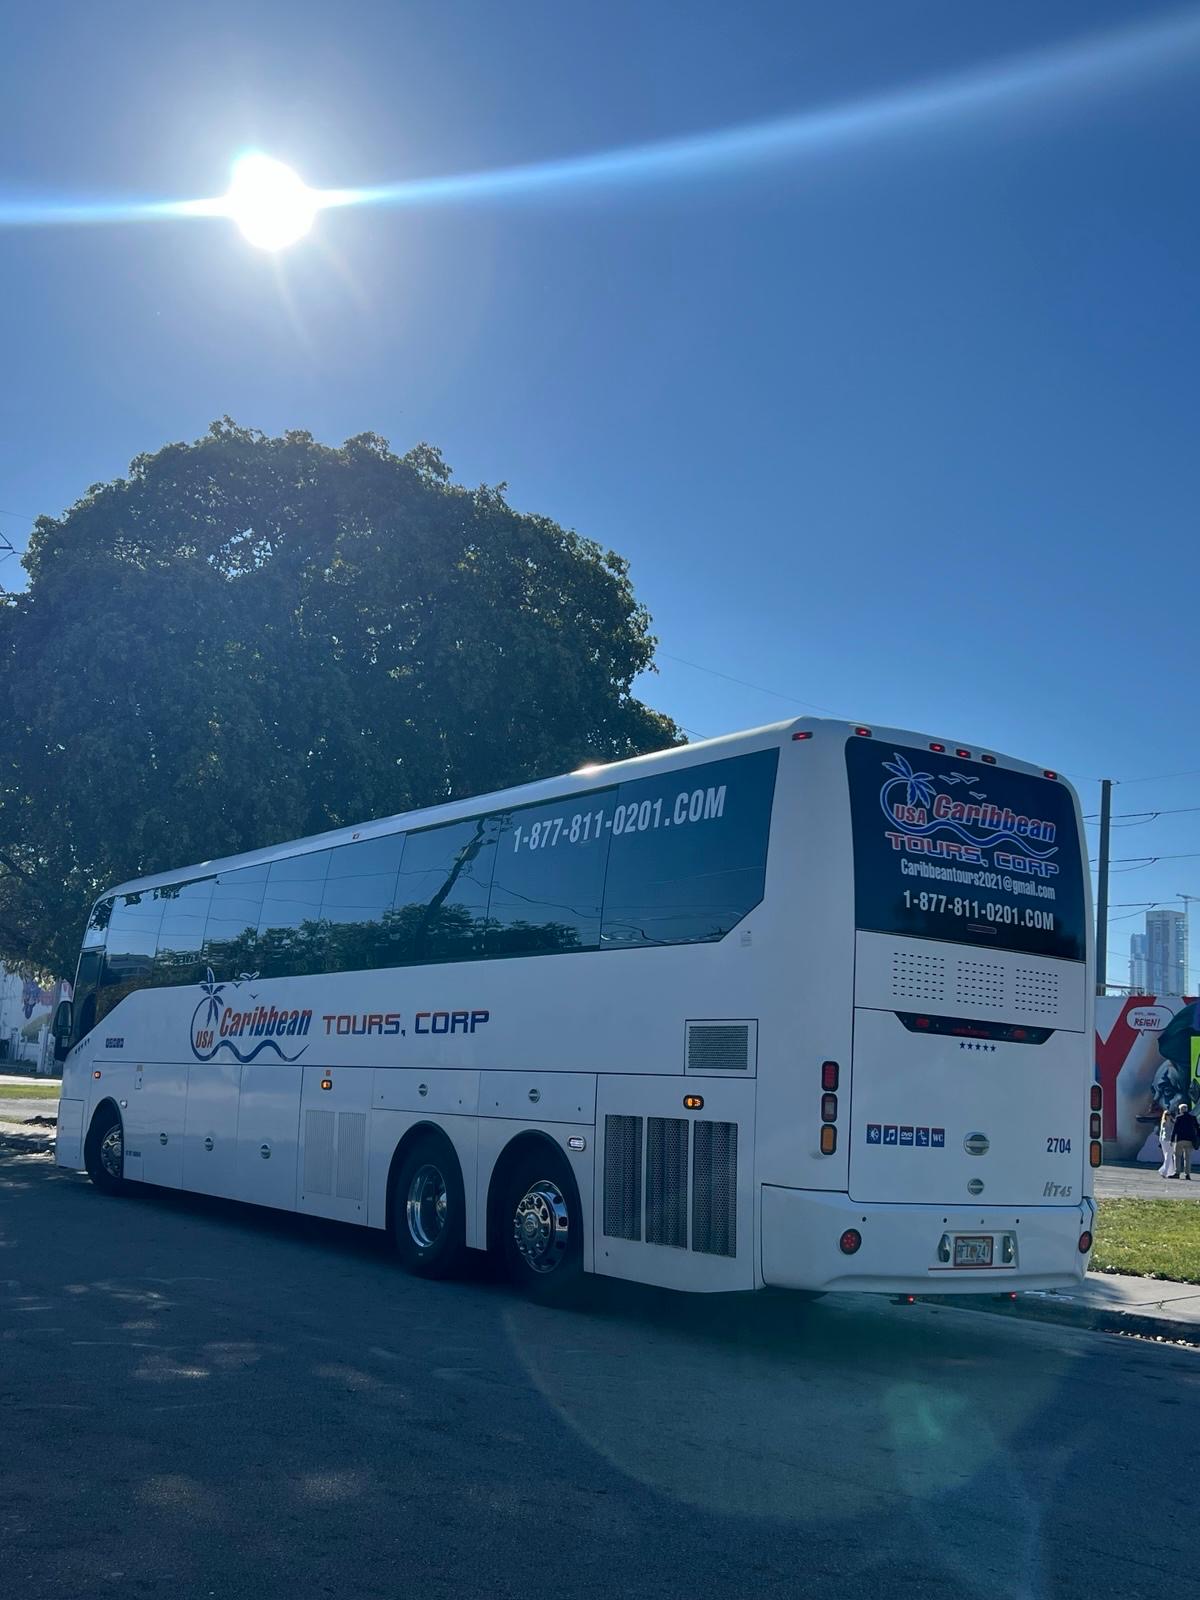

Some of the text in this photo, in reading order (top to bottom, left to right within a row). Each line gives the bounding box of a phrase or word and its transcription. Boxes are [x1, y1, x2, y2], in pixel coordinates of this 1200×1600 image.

[514, 785, 727, 853] 1-877-811-0201.COM
[893, 803, 928, 825] USA
[933, 793, 1056, 843] Caribbean
[885, 832, 1060, 878] TOURS, CORP
[901, 858, 1056, 900] Caribbeantours2021@gmail.com
[903, 890, 1055, 931] 1-877-811-0201.COM
[195, 1030, 214, 1049] USA
[219, 1005, 490, 1038] Caribbean TOURS, CORP
[1046, 1137, 1072, 1154] 2704
